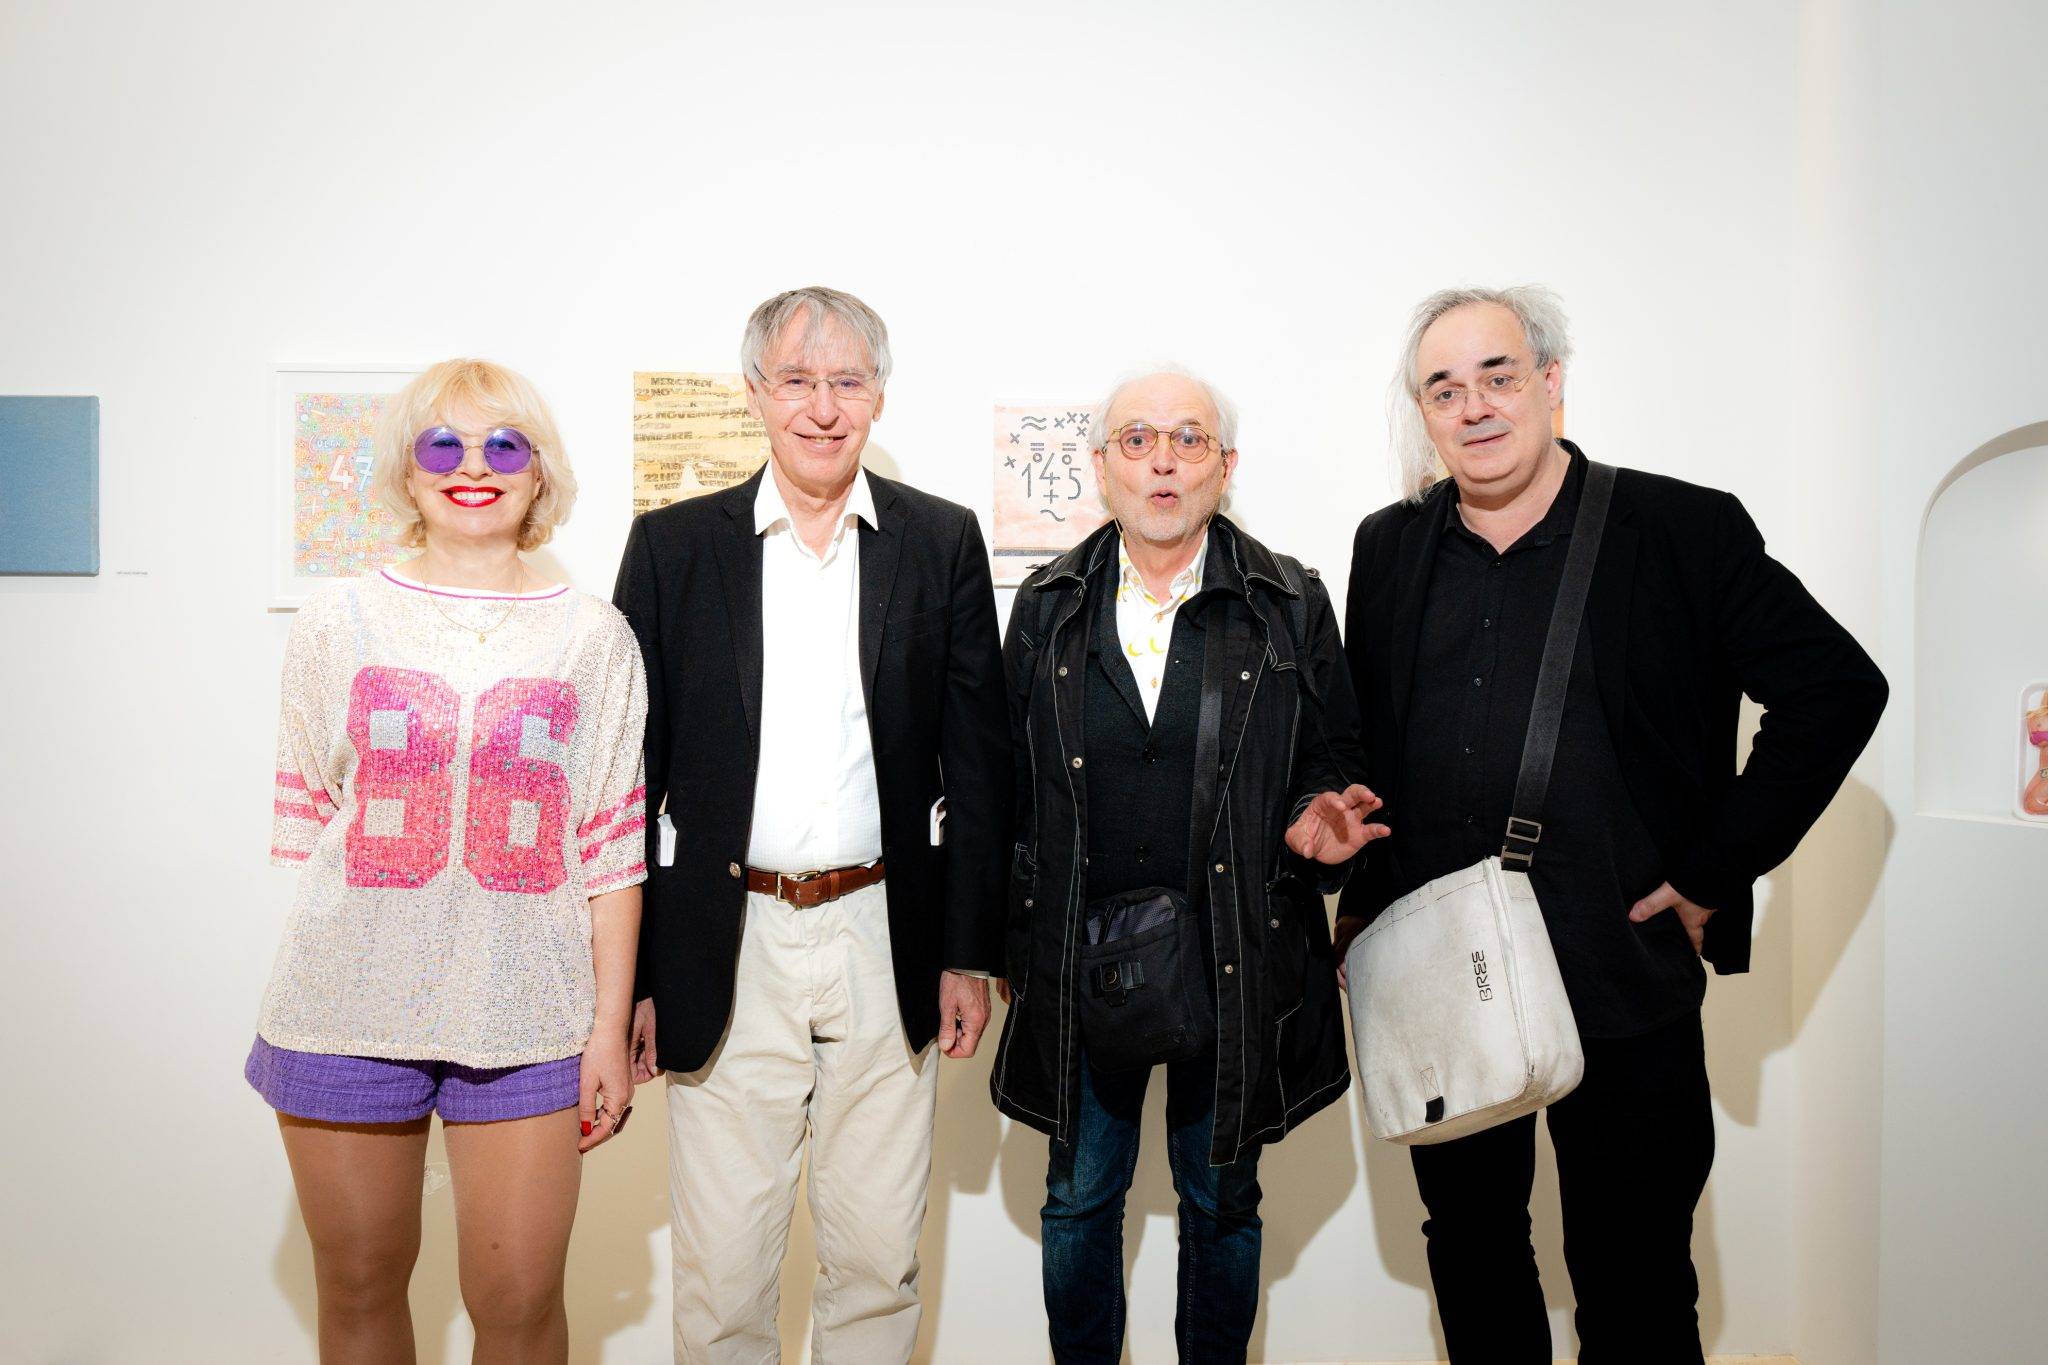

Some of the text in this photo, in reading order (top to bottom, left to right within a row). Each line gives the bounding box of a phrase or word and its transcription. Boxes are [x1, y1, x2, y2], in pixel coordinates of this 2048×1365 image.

[650, 377, 713, 388] MERCREDI
[328, 454, 375, 491] 47
[346, 665, 580, 894] 86
[1471, 949, 1494, 1002] BREE
